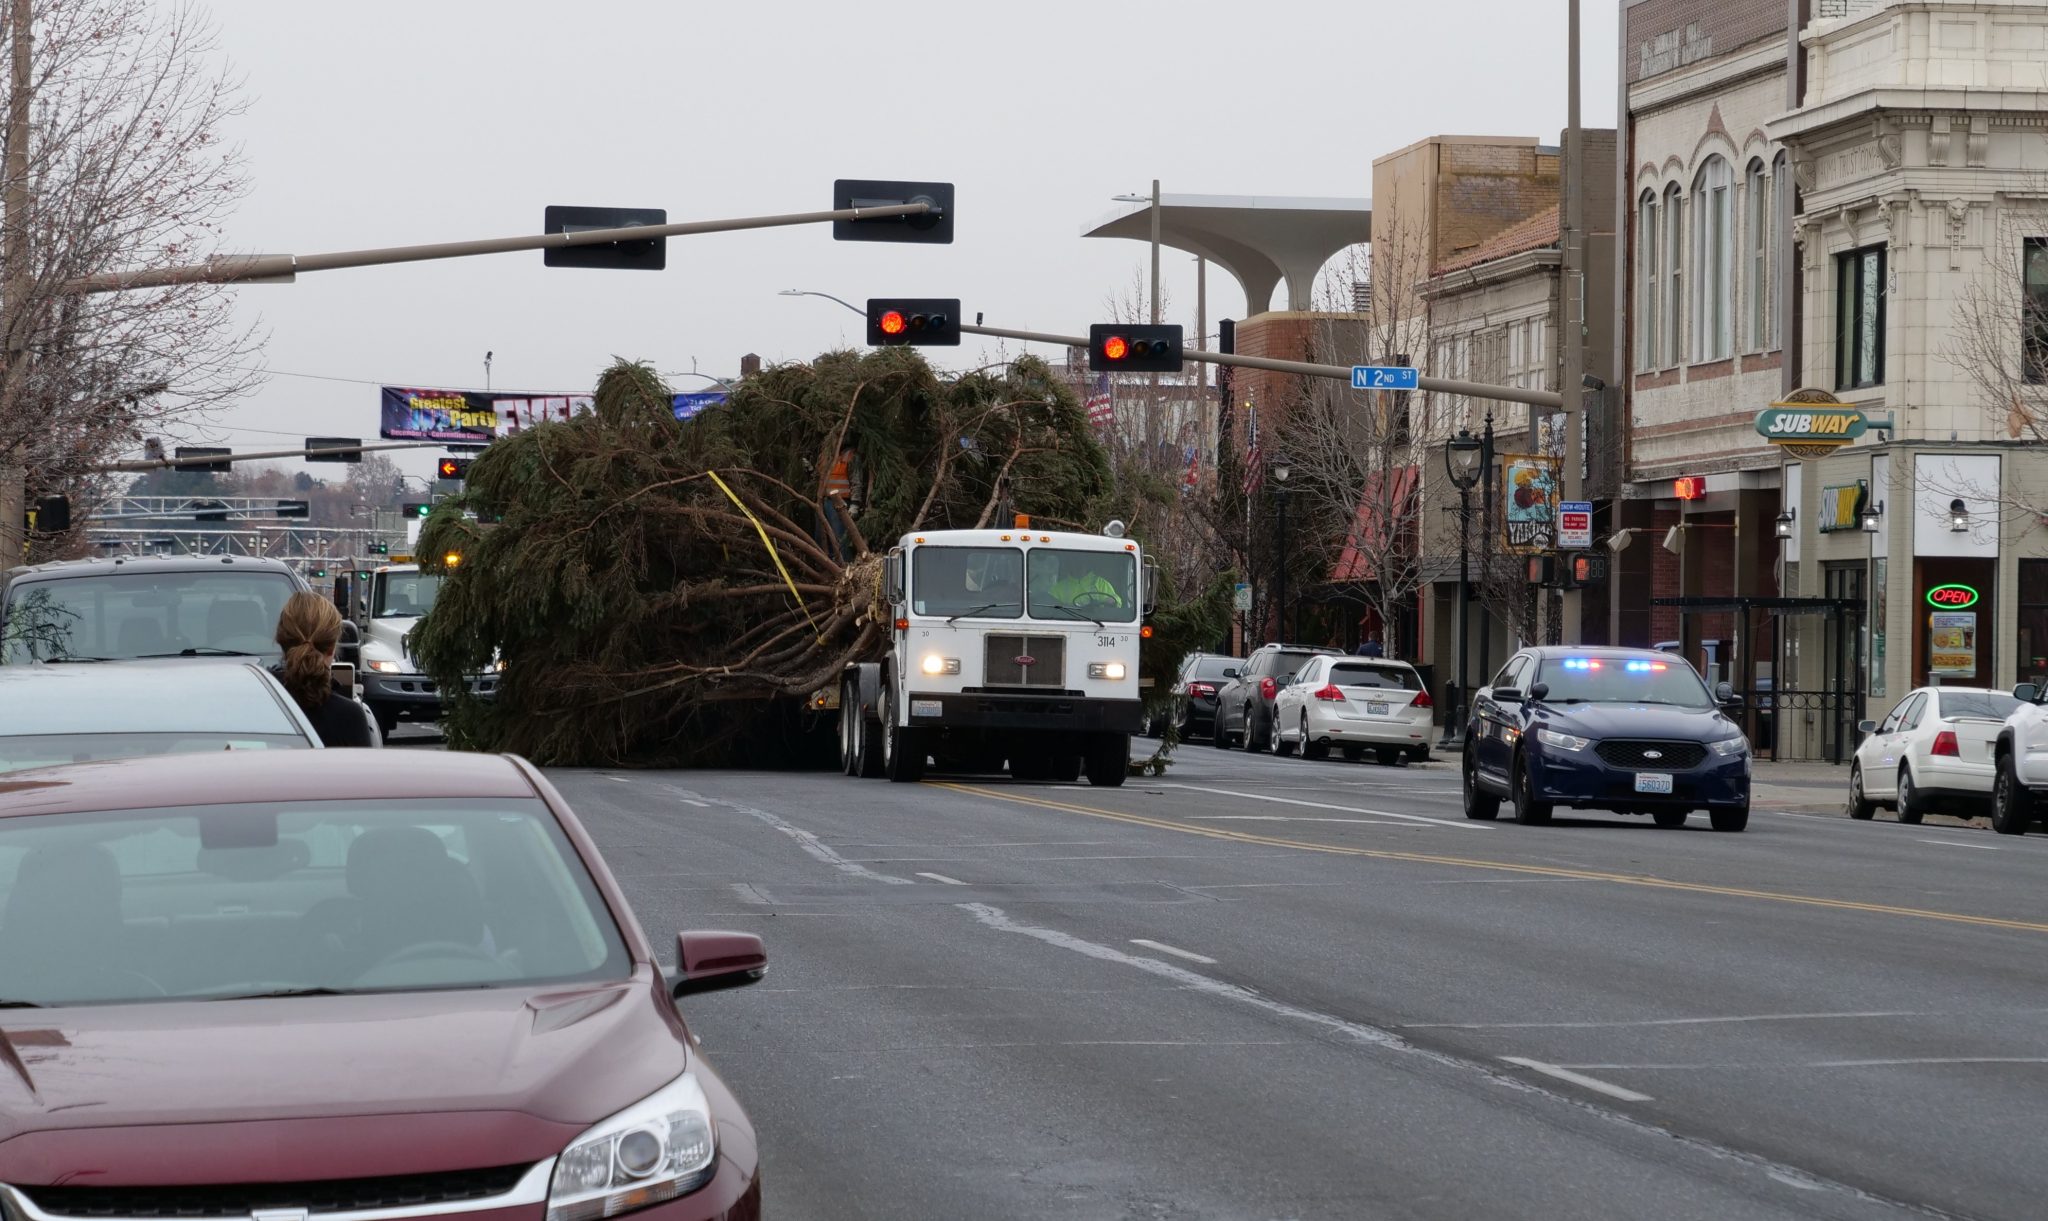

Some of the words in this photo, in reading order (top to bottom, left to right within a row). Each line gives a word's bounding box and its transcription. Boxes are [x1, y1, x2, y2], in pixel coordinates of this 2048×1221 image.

[1357, 370, 1367, 386] N
[1374, 370, 1394, 386] 2ND
[1402, 371, 1412, 380] ST
[1768, 413, 1860, 434] SUBWAY
[1819, 484, 1860, 530] SUBWAY
[1933, 588, 1972, 604] OPEN
[1097, 636, 1115, 648] 3114
